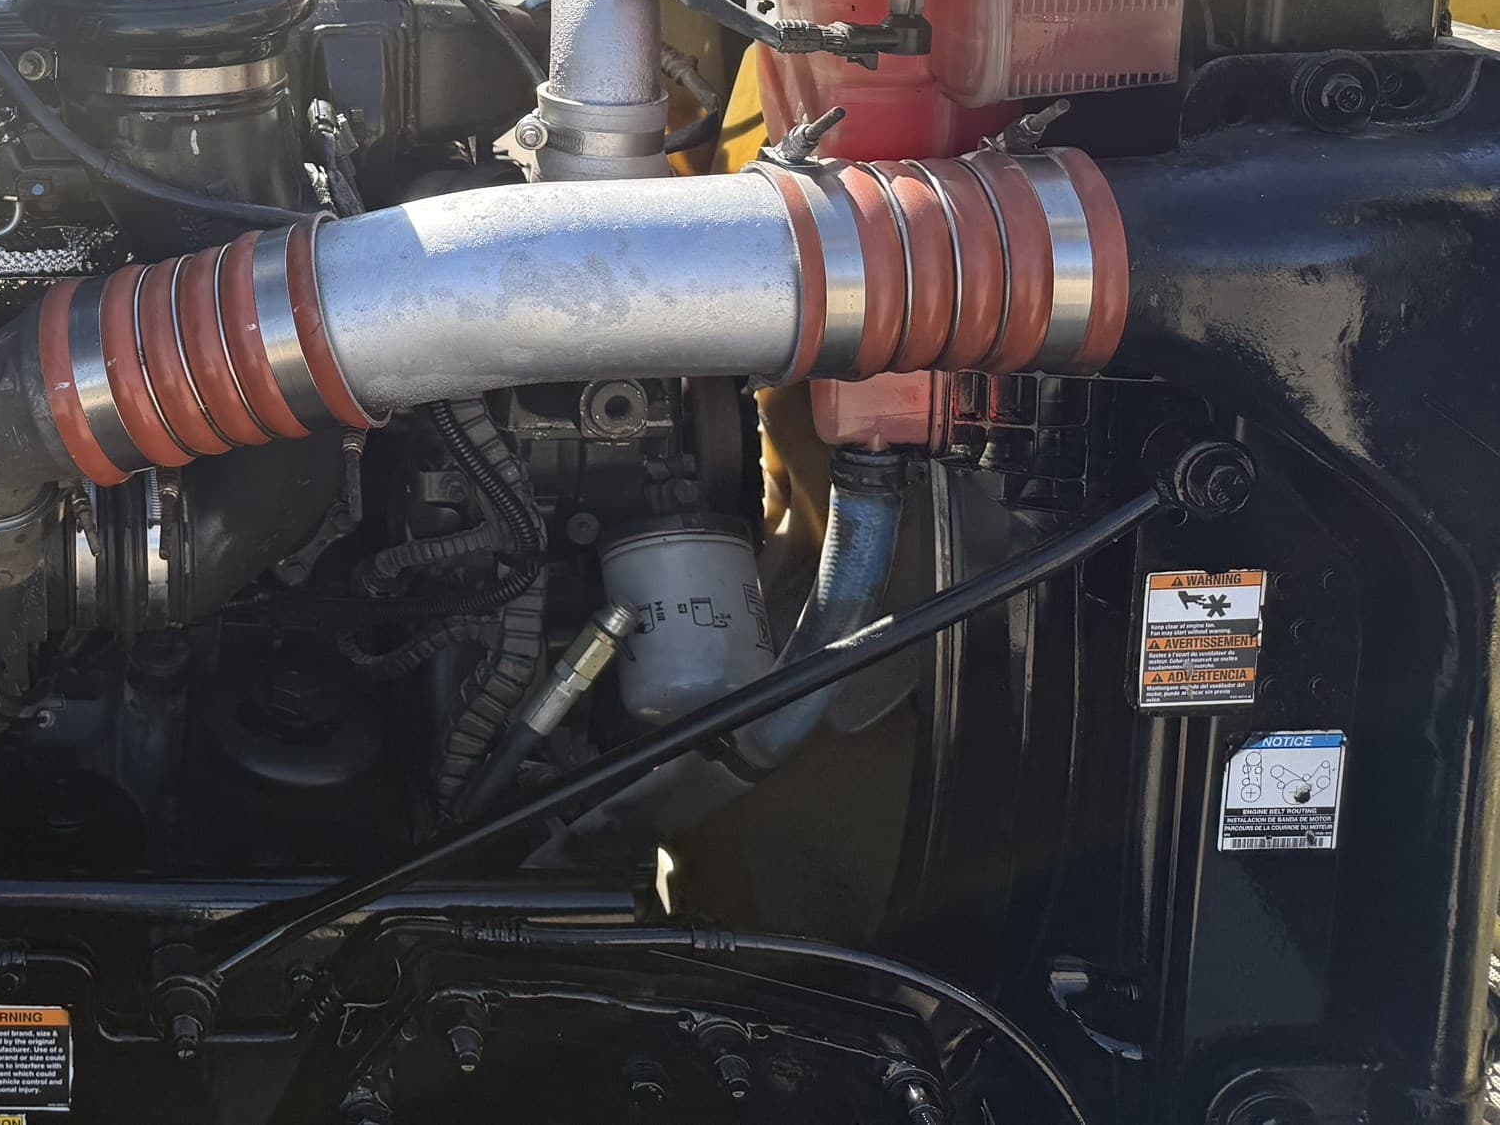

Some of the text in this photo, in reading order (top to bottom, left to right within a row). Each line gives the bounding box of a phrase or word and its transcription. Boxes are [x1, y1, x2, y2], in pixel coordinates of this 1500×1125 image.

[1186, 574, 1242, 586] WARNING
[1164, 635, 1254, 649] AVERTISSEMENT
[1167, 669, 1247, 682] ADVERTENCIA
[1262, 736, 1313, 747] NOTICE
[4, 1038, 13, 1046] by
[27, 1038, 56, 1046] original
